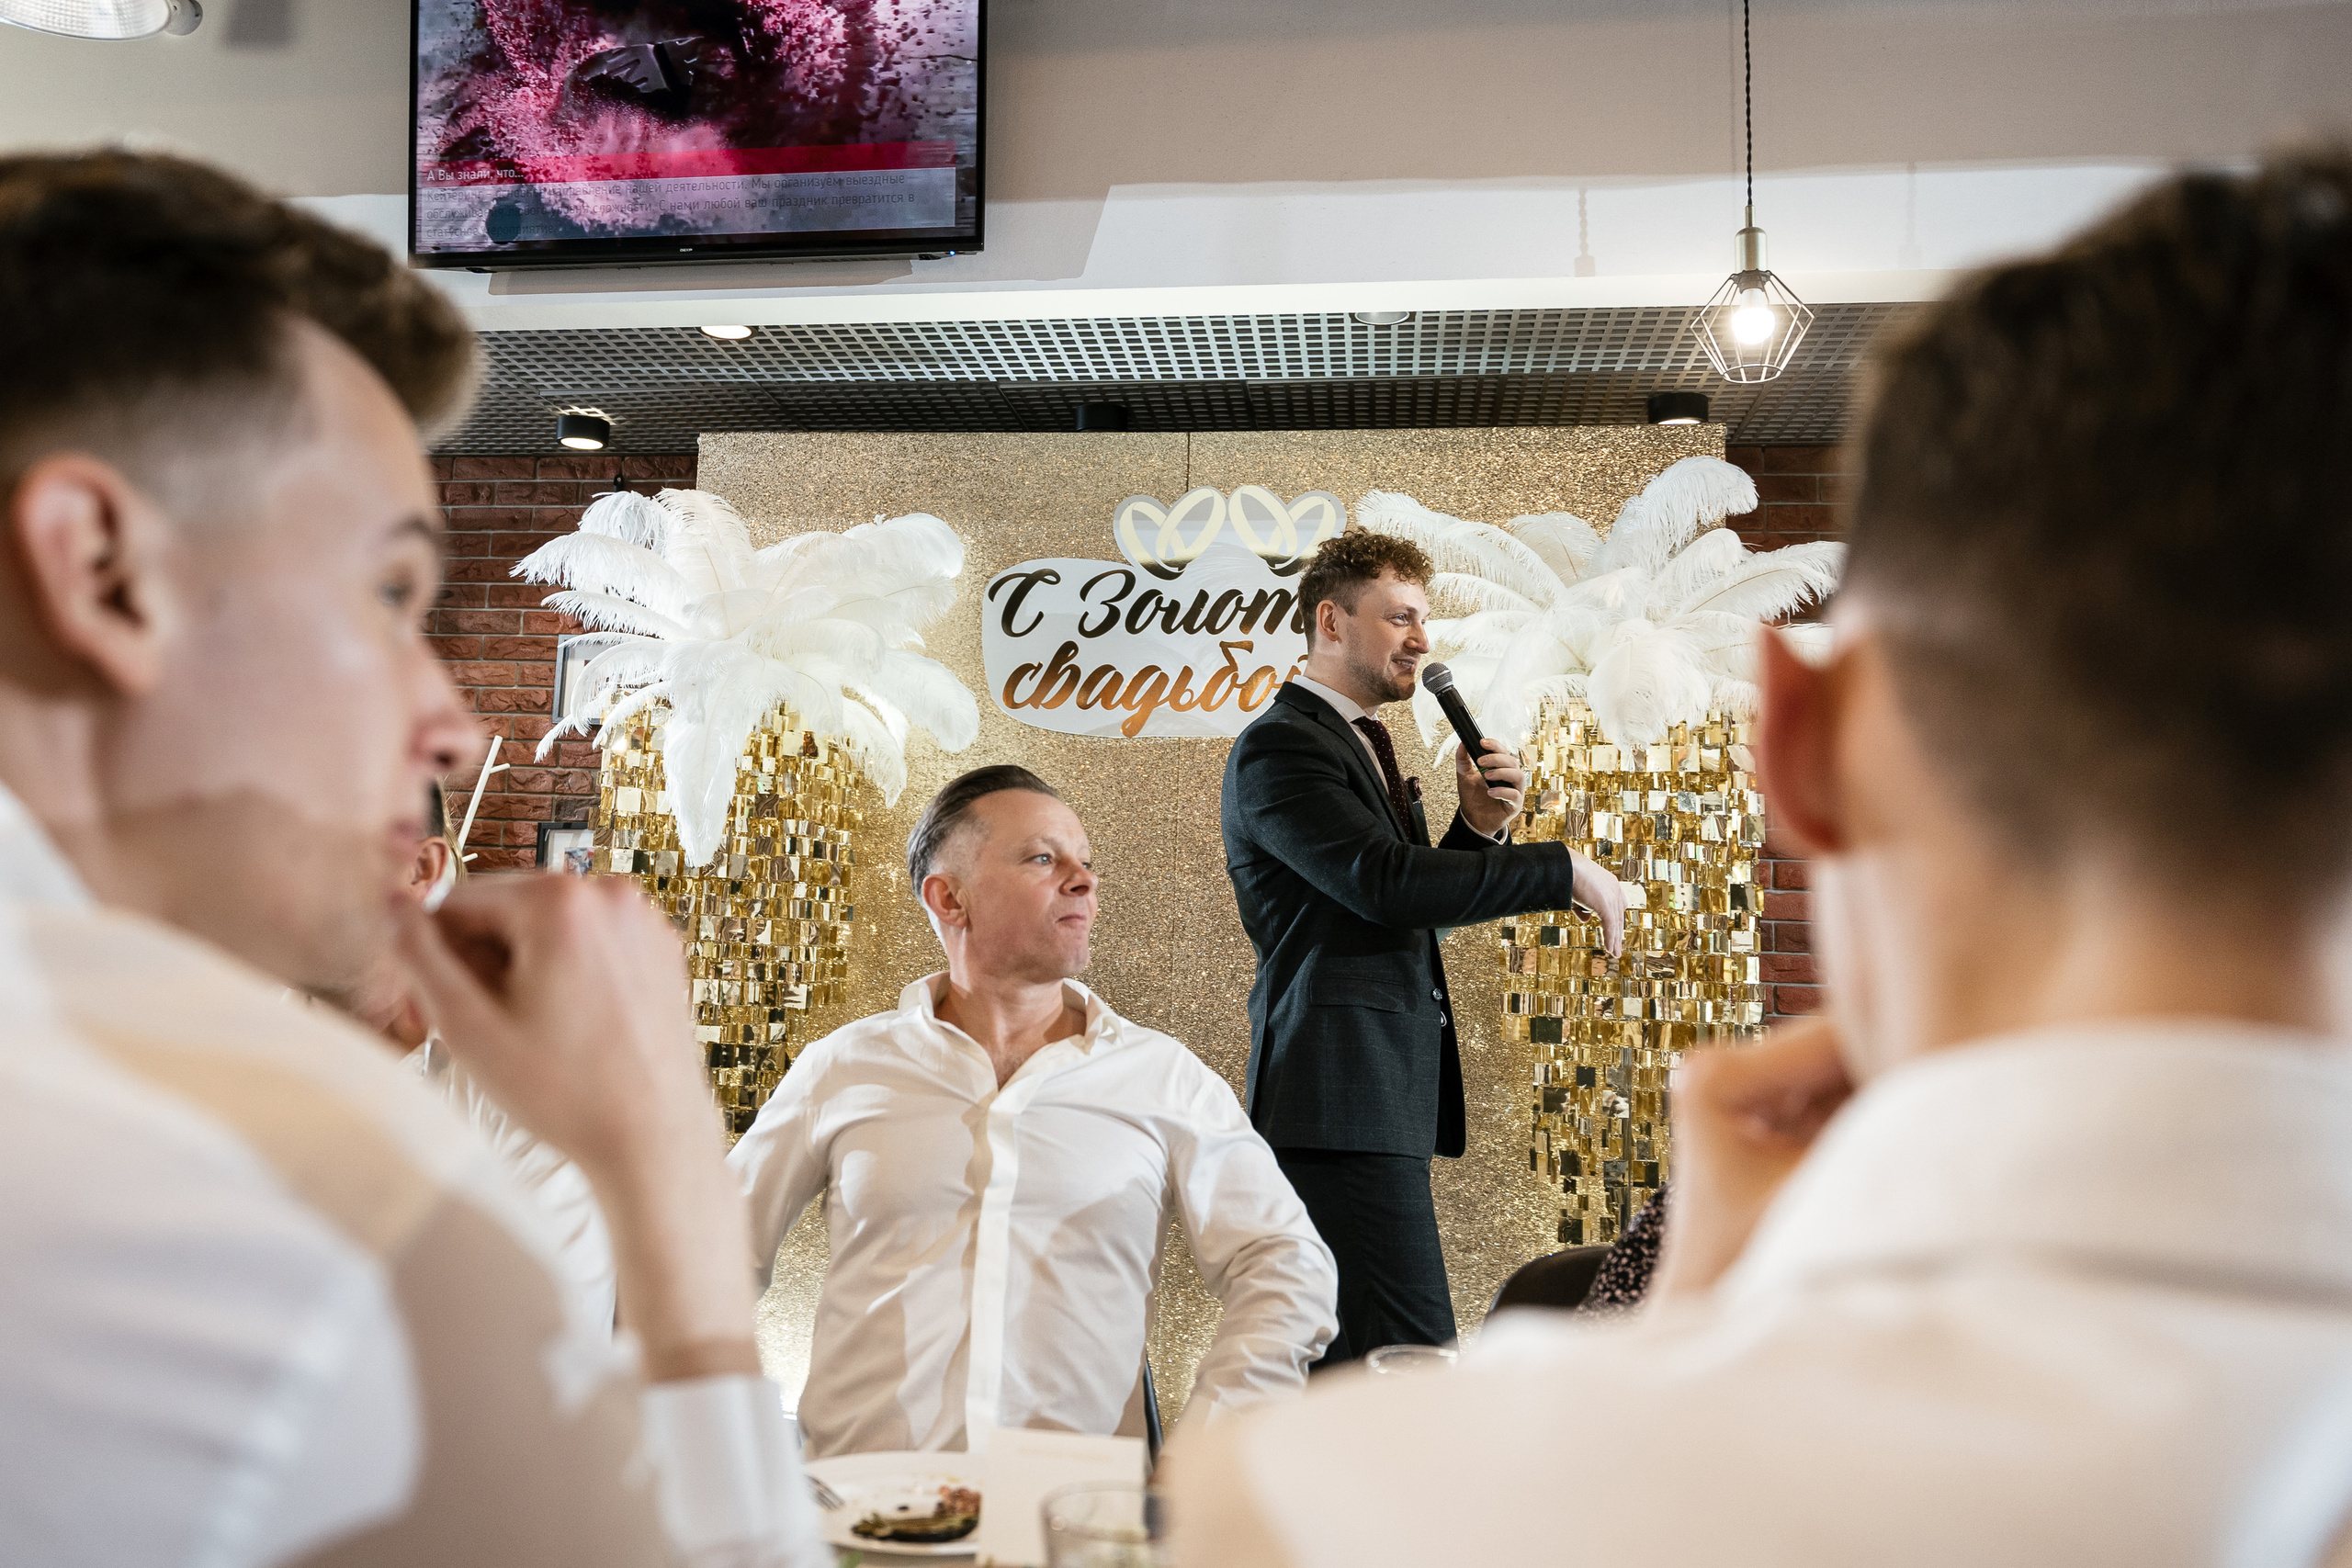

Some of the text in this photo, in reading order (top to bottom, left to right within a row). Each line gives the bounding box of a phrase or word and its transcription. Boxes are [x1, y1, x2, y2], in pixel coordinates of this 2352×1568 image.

[426, 168, 525, 181] А Вы знали, что...
[548, 185, 621, 198] направление
[626, 183, 662, 193] нашей
[665, 179, 748, 194] деятельности.
[751, 177, 771, 189] Мы
[775, 176, 842, 190] организуем
[846, 175, 906, 187] выездные
[593, 202, 655, 213] сложности.
[659, 199, 666, 211] С
[670, 200, 700, 212] нами
[703, 197, 741, 209] любой
[745, 197, 767, 209] ваш
[772, 196, 827, 209] праздник
[831, 193, 904, 207] превратится
[908, 193, 915, 203] в
[988, 568, 1305, 638] С Золот
